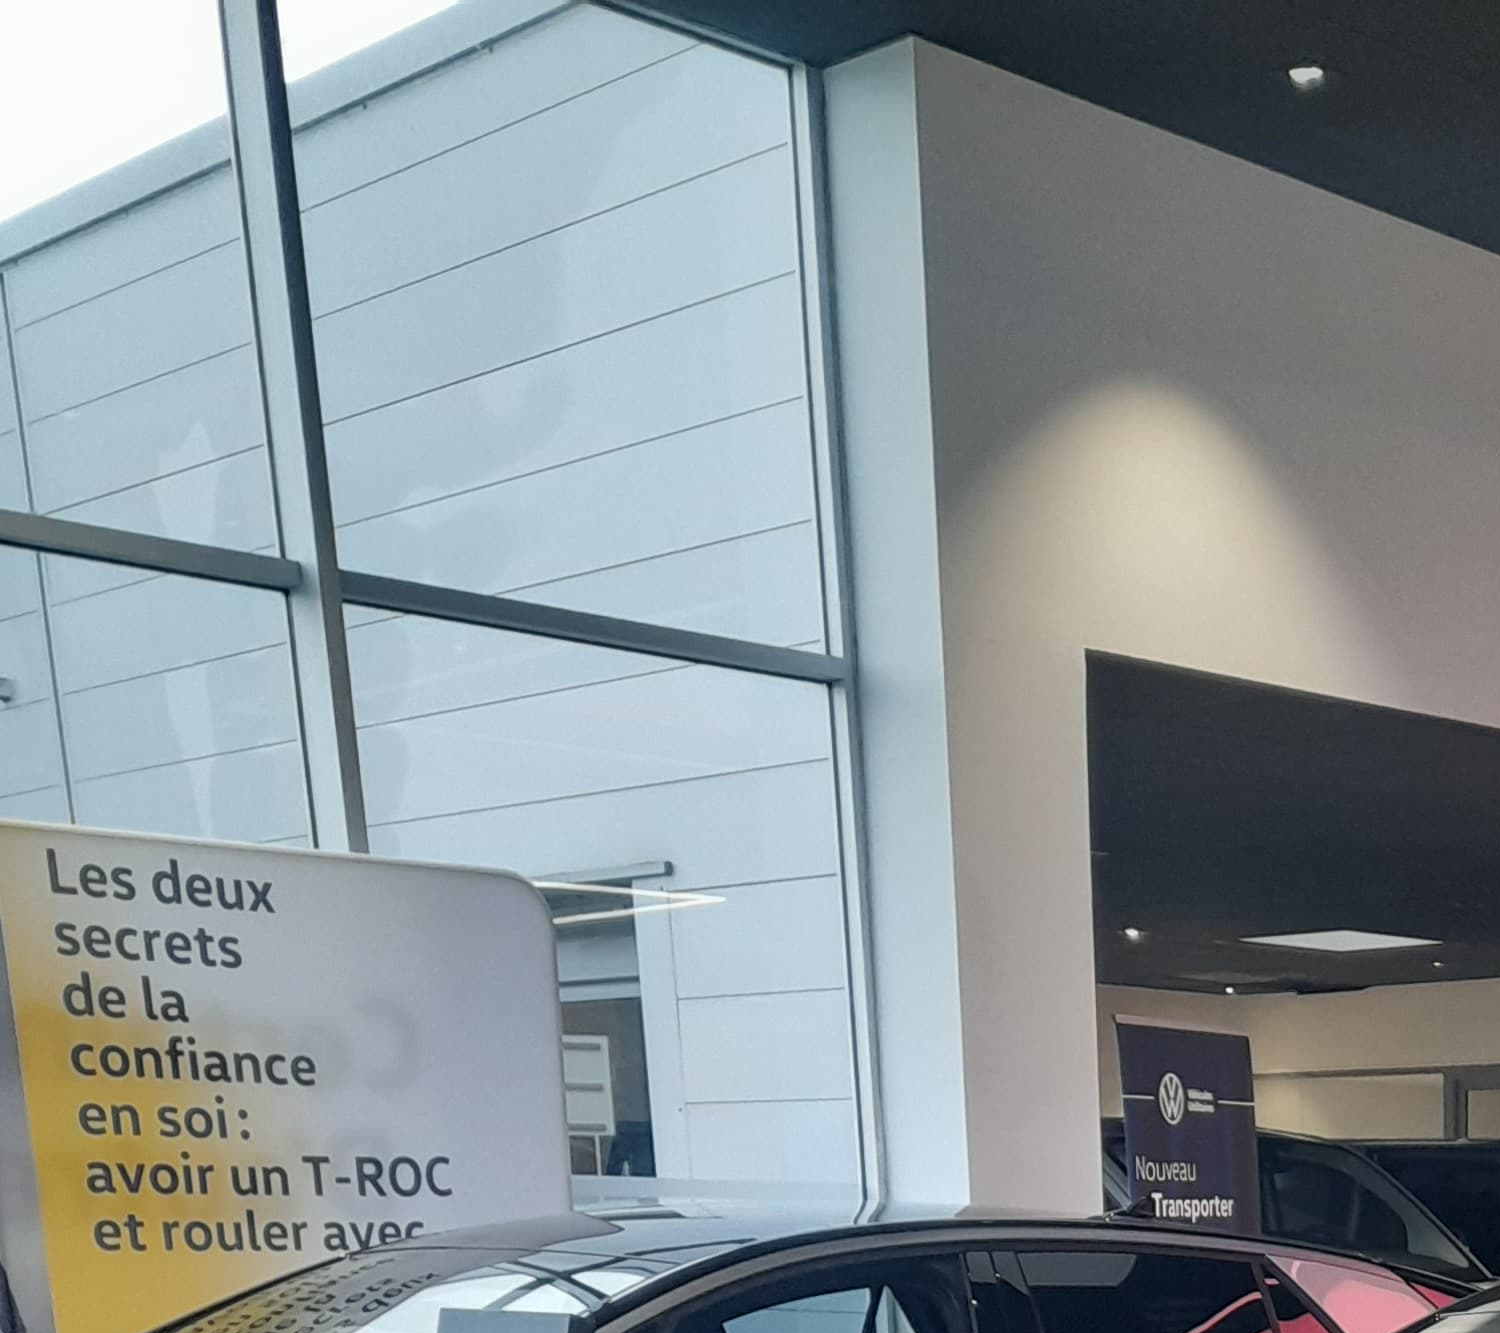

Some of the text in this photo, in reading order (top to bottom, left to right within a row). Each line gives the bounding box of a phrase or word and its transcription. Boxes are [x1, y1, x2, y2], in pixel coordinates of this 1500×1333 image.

[46, 848, 275, 914] Les deux
[54, 921, 242, 969] secrets
[63, 971, 190, 1023] de la
[70, 1036, 316, 1086] confiance
[78, 1102, 141, 1137] en
[86, 1151, 453, 1197] avoir un T-ROC
[1135, 1156, 1196, 1182] Nouveau
[94, 1214, 147, 1252] et
[162, 1209, 308, 1252] rouler
[1151, 1192, 1234, 1224] Transporter
